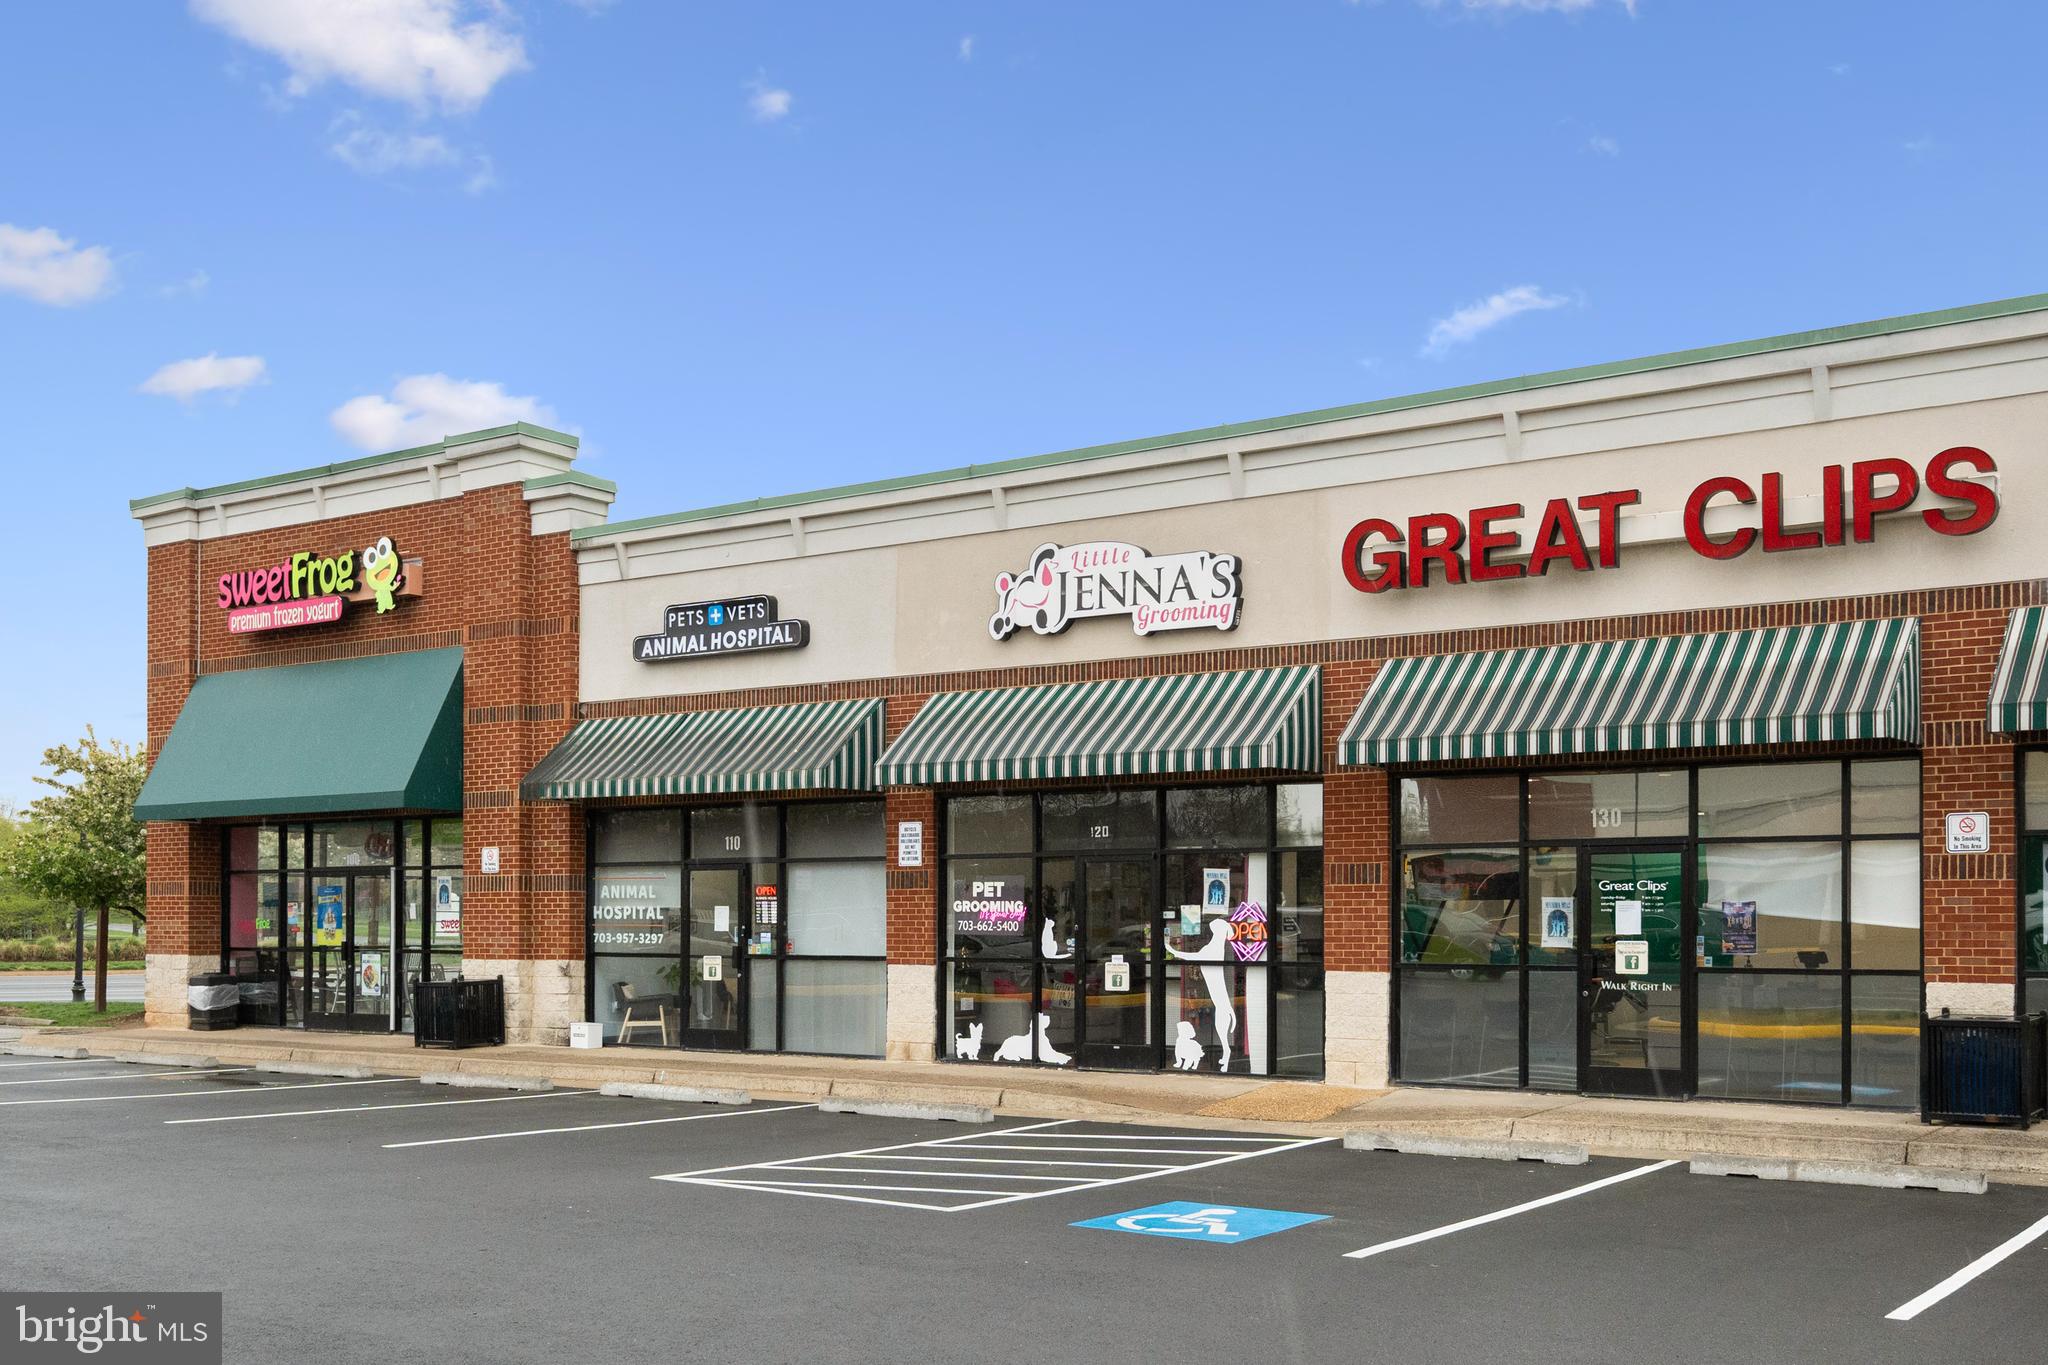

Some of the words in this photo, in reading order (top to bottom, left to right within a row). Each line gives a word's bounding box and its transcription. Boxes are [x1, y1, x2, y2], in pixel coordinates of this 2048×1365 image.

[1341, 488, 1641, 594] GREAT
[1684, 446, 2000, 560] CLIPS
[1071, 547, 1130, 573] Little
[1058, 555, 1234, 627] JENNA'S
[230, 609, 271, 632] premium
[274, 606, 304, 625] frozen
[306, 600, 340, 620] yogurt
[668, 609, 705, 628] PETS
[726, 602, 765, 622] VETS
[1137, 598, 1232, 631] Grooming
[641, 636, 708, 658] ANIMAL
[710, 624, 794, 651] HOSPITAL
[1590, 807, 1622, 828] 130
[1090, 825, 1109, 838] 120
[725, 836, 740, 850] 110
[756, 886, 776, 896] OPEN
[972, 882, 1005, 897] PET
[1598, 880, 1634, 890] Great
[600, 886, 656, 899] ANIMAL
[593, 906, 664, 920] HOSPITAL
[953, 900, 1024, 912] GROOMING
[958, 920, 1019, 932] 703-662-5400
[593, 933, 664, 944] 703-957-3297
[1601, 980, 1627, 990] WALK
[1630, 981, 1659, 991] RIGHT
[1662, 982, 1672, 991] IN
